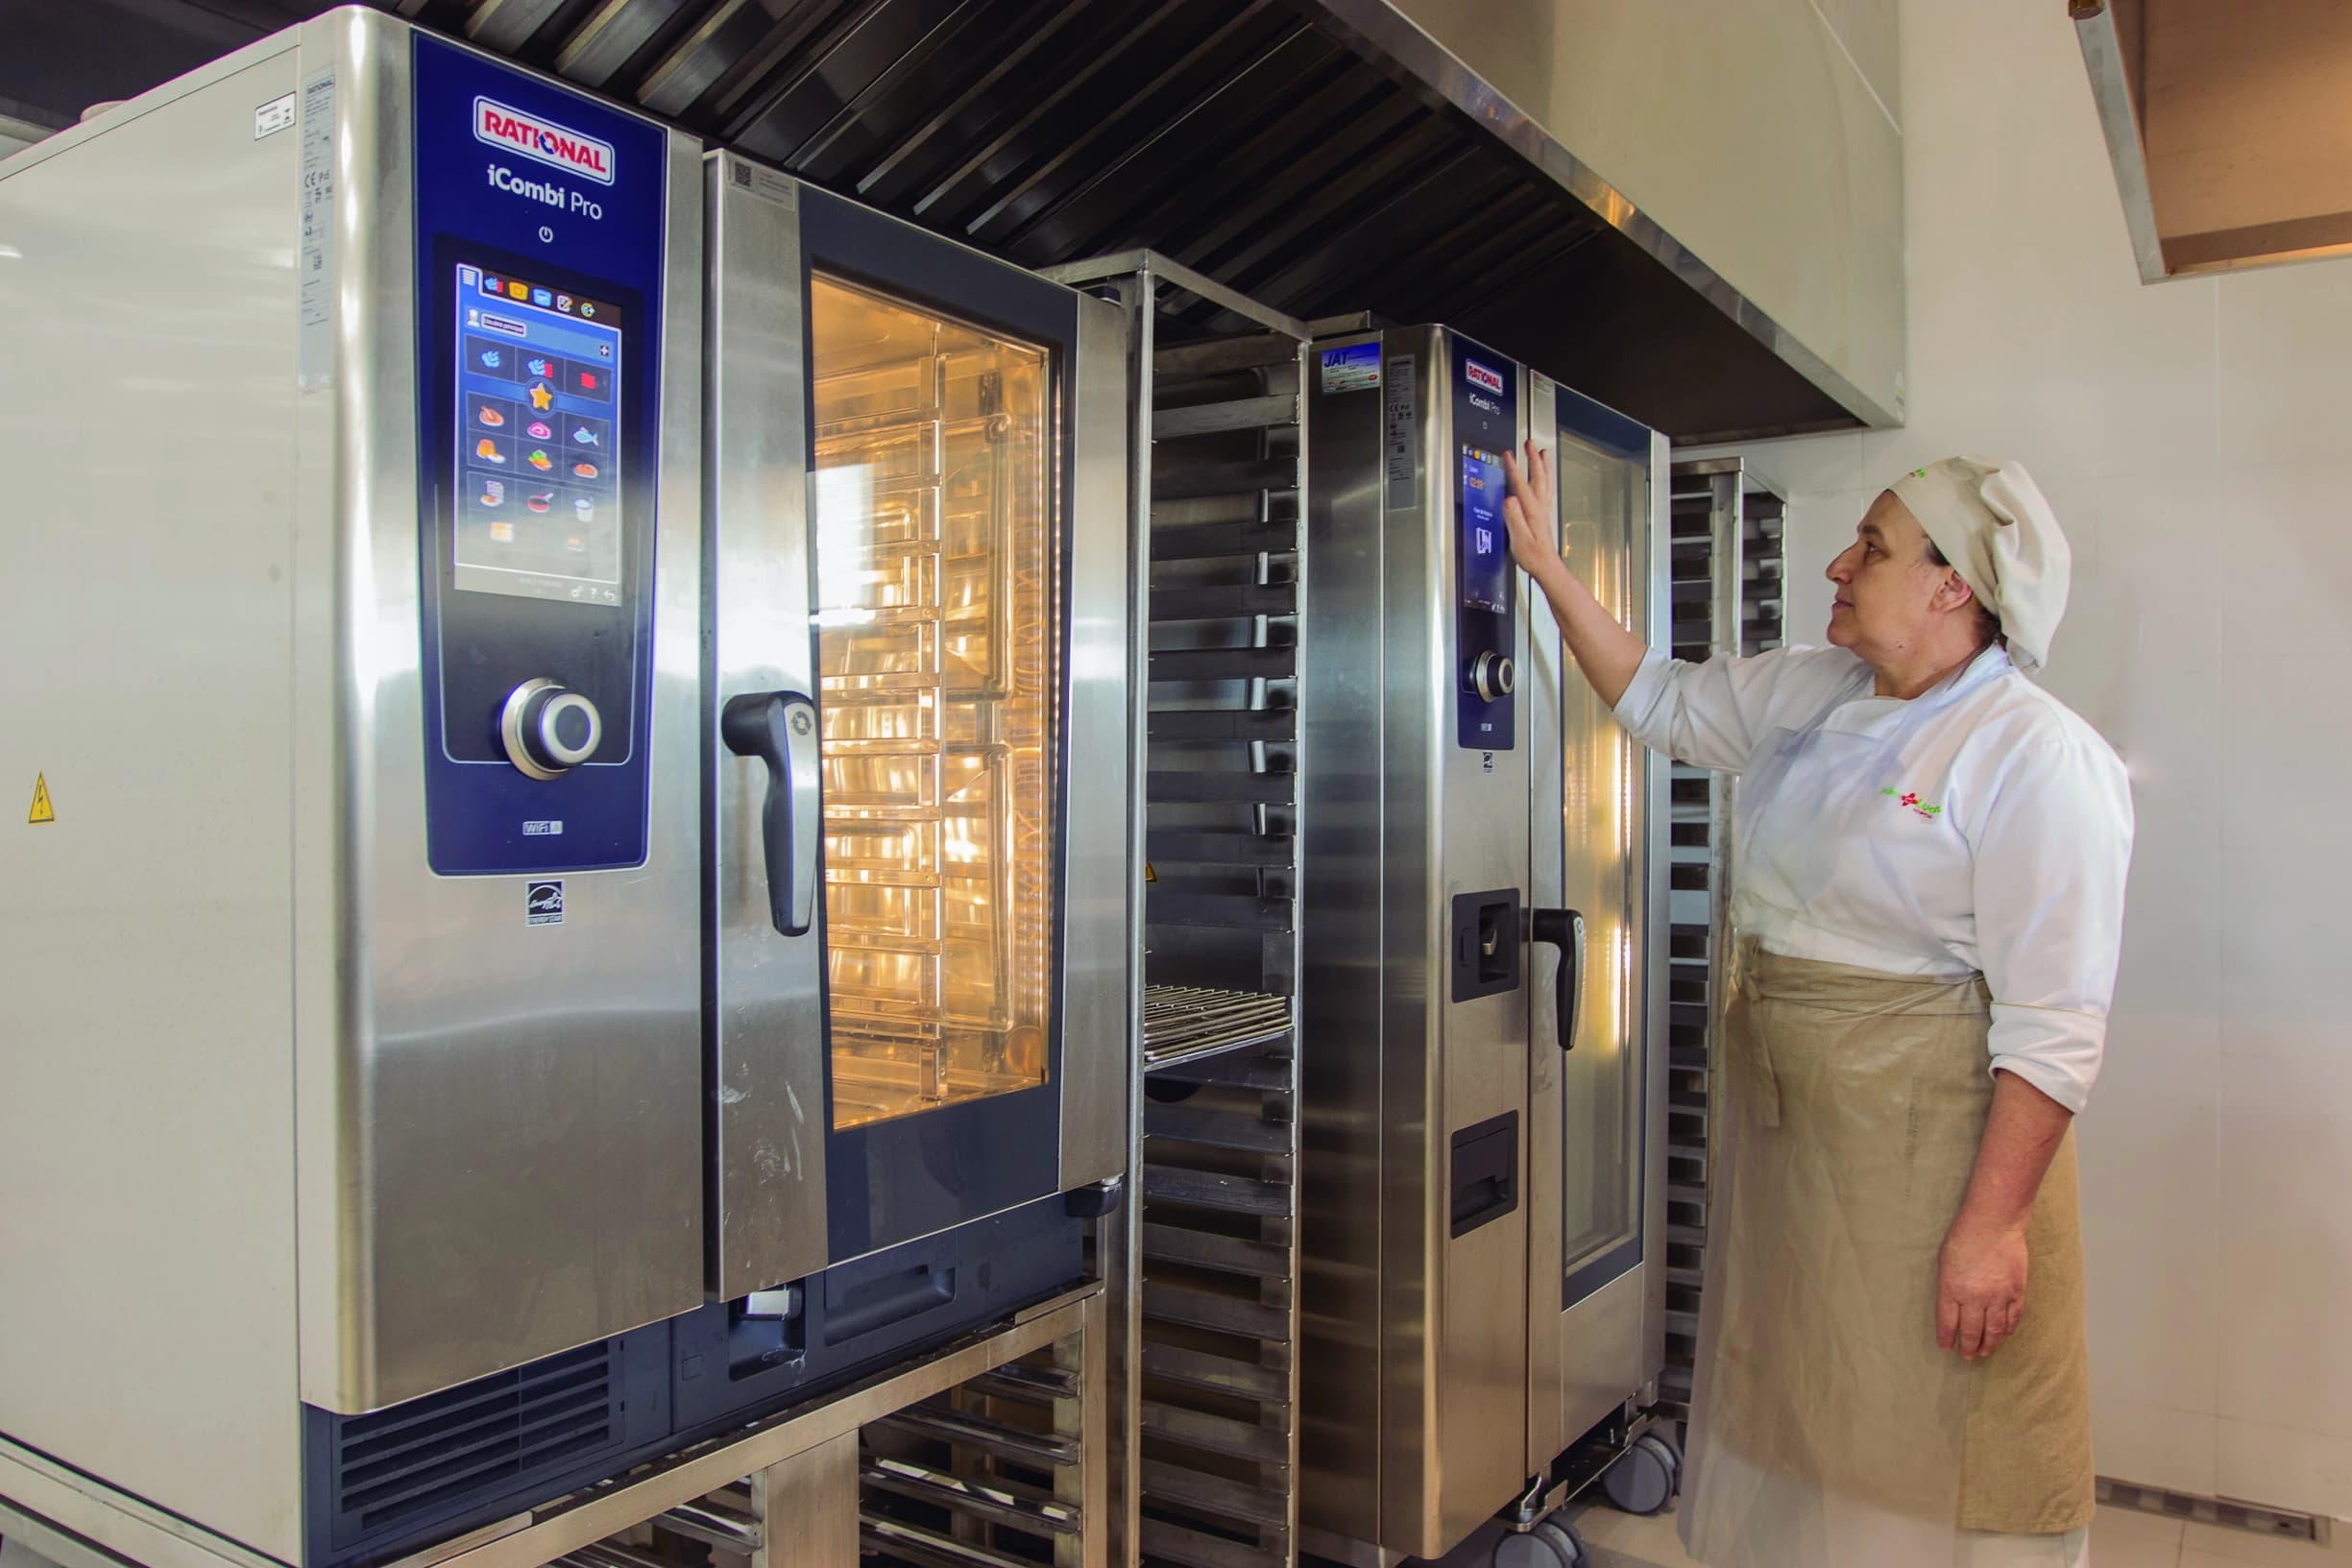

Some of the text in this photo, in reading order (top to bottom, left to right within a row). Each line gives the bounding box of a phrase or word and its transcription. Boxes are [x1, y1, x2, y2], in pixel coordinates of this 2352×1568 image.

[485, 109, 607, 173] RATIONAL
[488, 164, 603, 220] iCombi Pro
[1323, 351, 1349, 368] JAT
[1467, 365, 1502, 390] RATIONAL
[1469, 392, 1491, 411] iCombi
